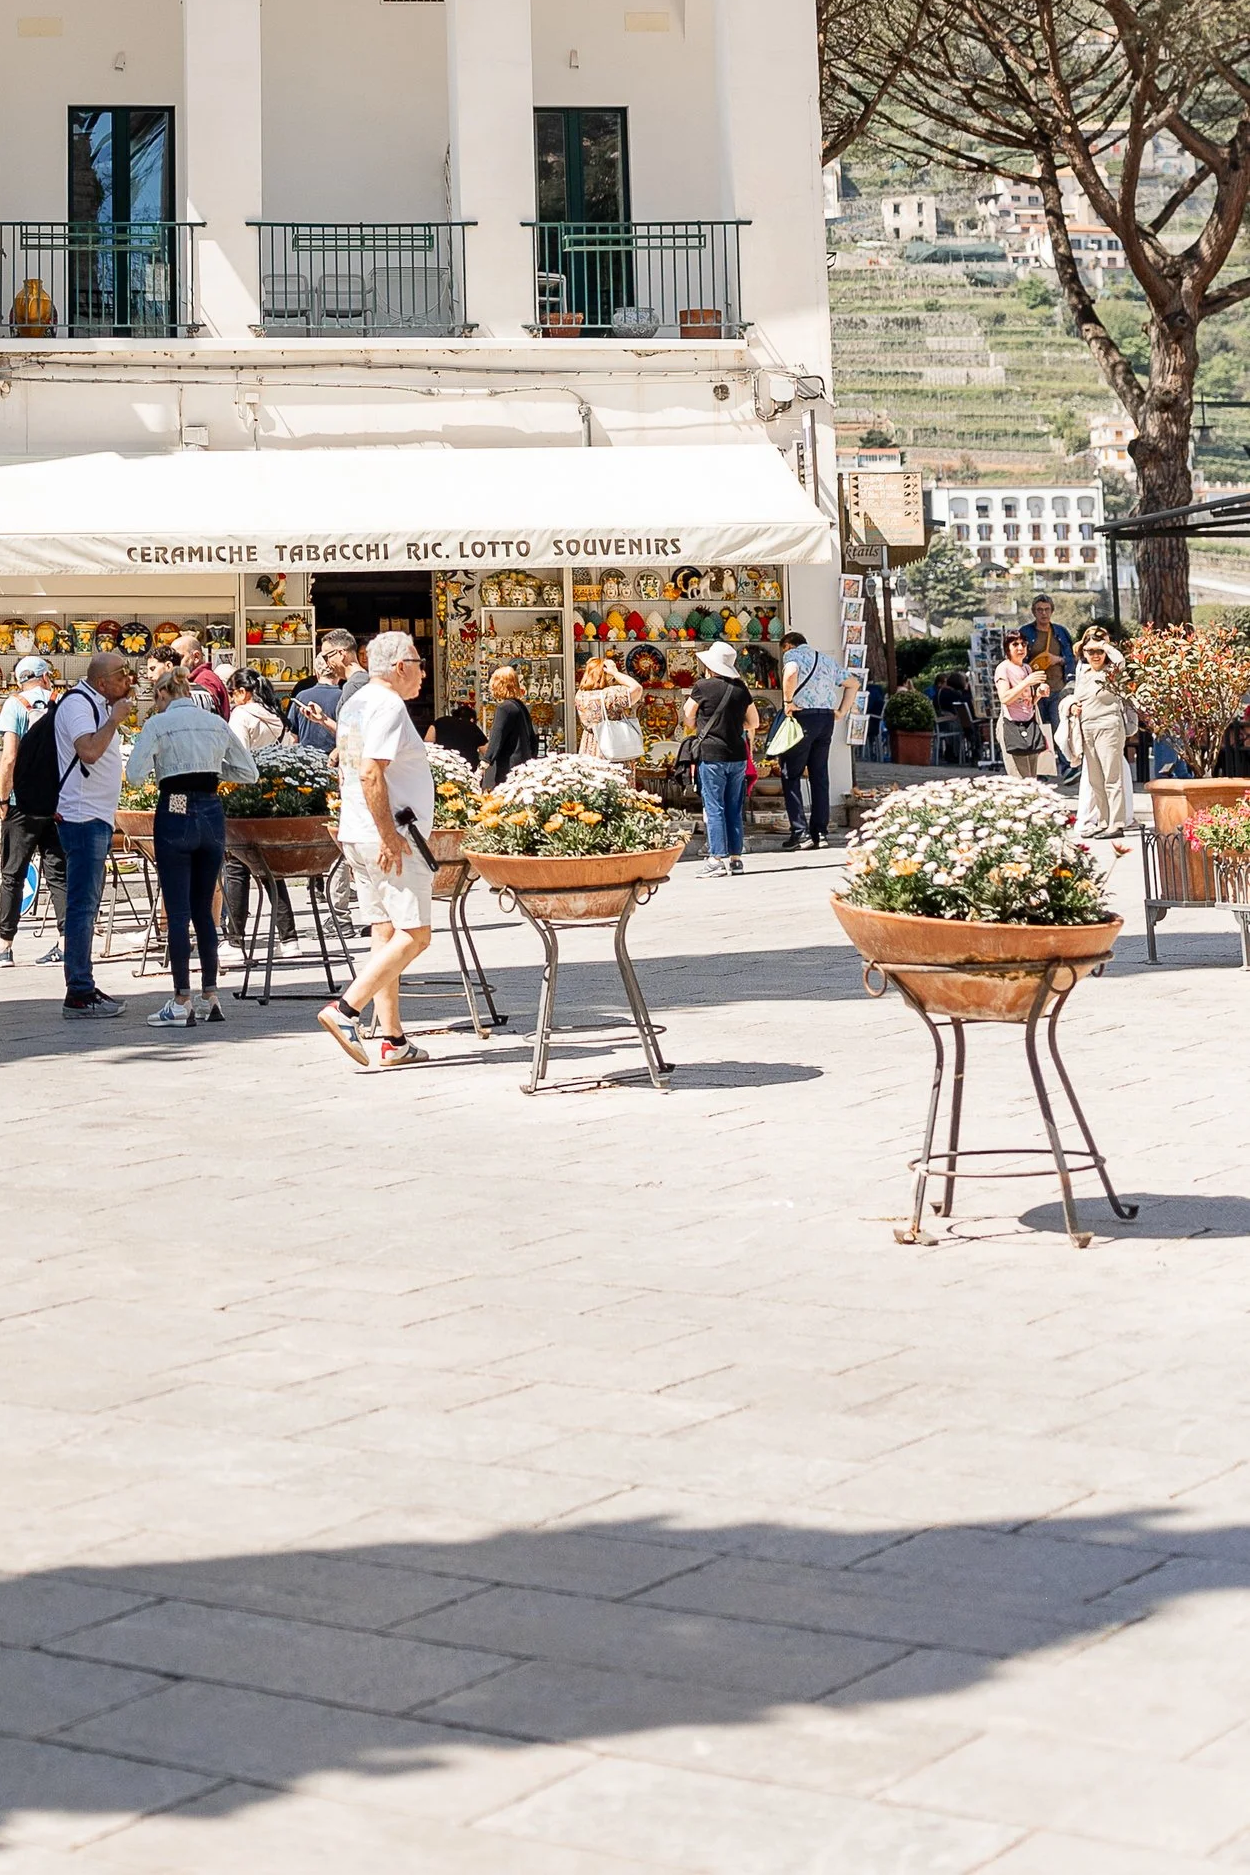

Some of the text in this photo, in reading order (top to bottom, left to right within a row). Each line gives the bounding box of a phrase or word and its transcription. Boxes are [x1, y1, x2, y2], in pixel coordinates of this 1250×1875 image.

[126, 538, 681, 564] CERAMICHE TABACCHI RIC. LOTTO SOUVENIRS
